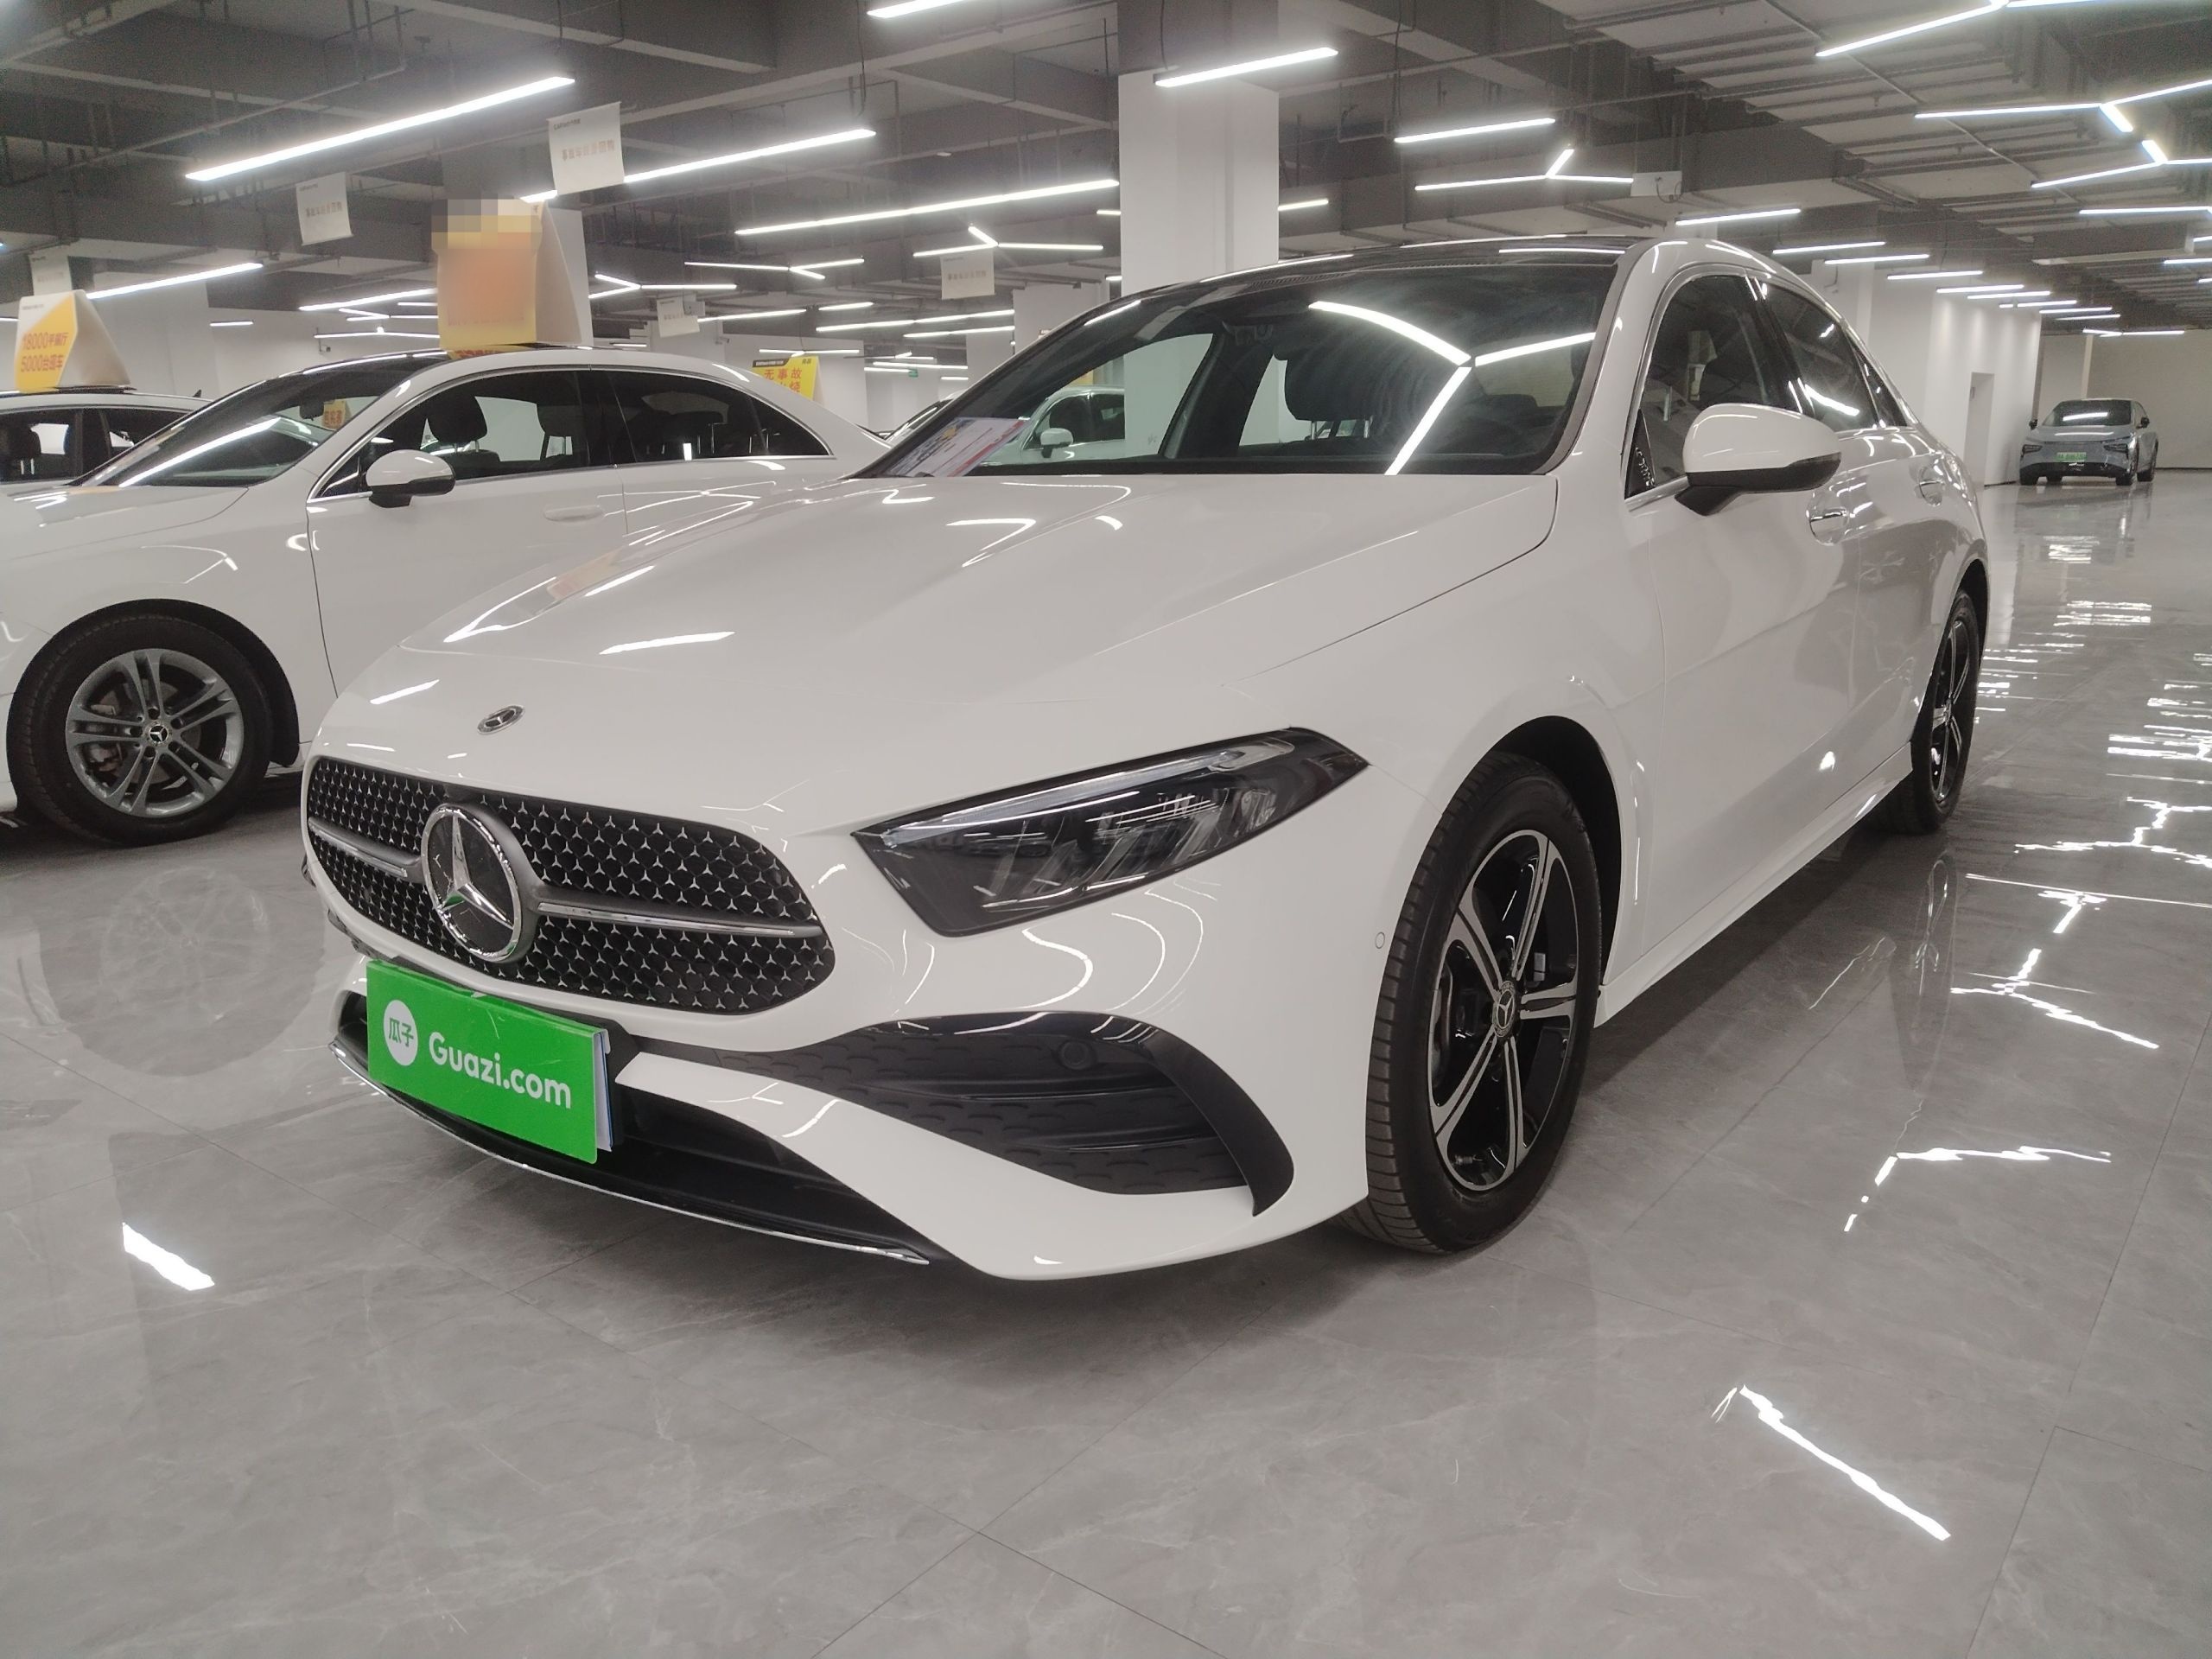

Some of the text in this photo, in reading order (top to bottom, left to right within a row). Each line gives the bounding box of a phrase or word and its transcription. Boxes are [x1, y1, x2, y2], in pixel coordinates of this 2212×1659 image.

[765, 367, 802, 380] 无事故
[389, 1018, 414, 1047] 瓜子
[429, 1032, 571, 1109] Guazi.com
